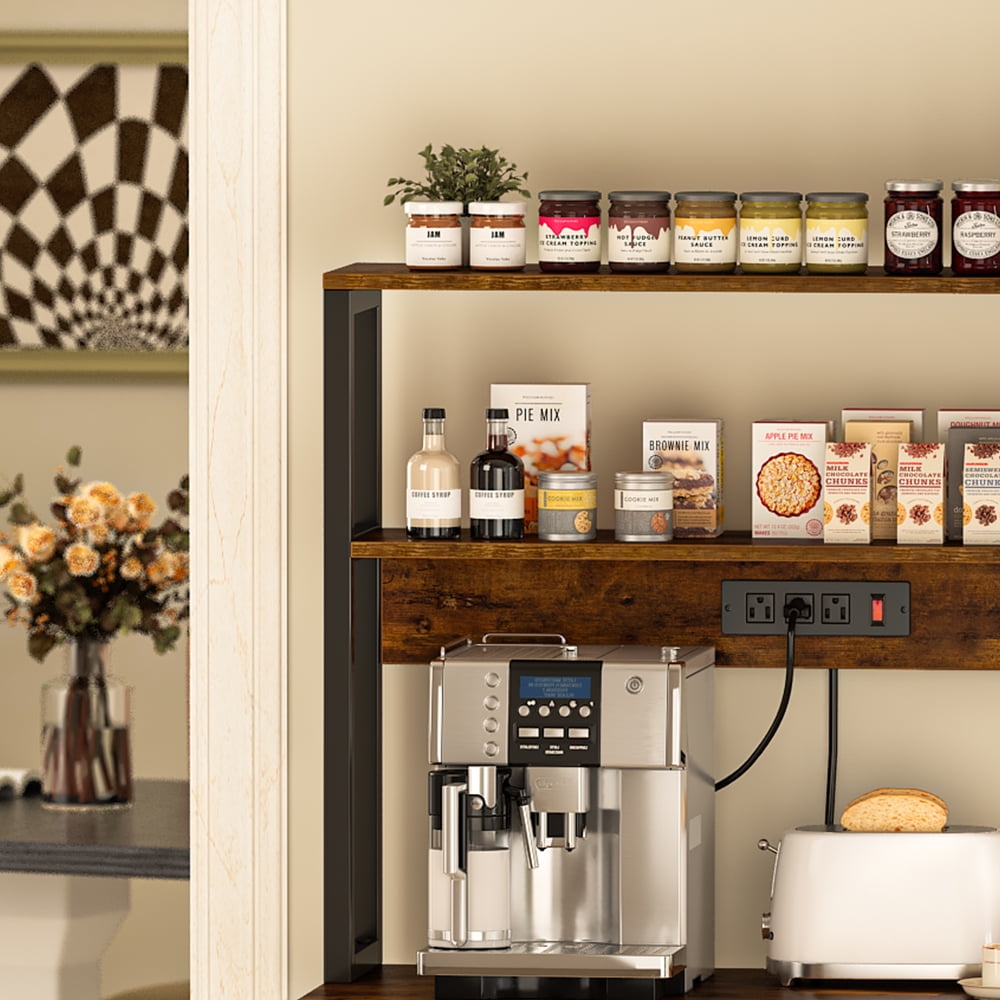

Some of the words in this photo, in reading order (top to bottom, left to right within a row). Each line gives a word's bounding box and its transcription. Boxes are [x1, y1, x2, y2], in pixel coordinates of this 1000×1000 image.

[427, 230, 441, 238] JAM
[491, 231, 505, 239] JAM
[516, 408, 534, 422] PIE
[540, 408, 561, 422] MIX
[649, 440, 689, 452] BROWNIE
[694, 440, 710, 452] MIX
